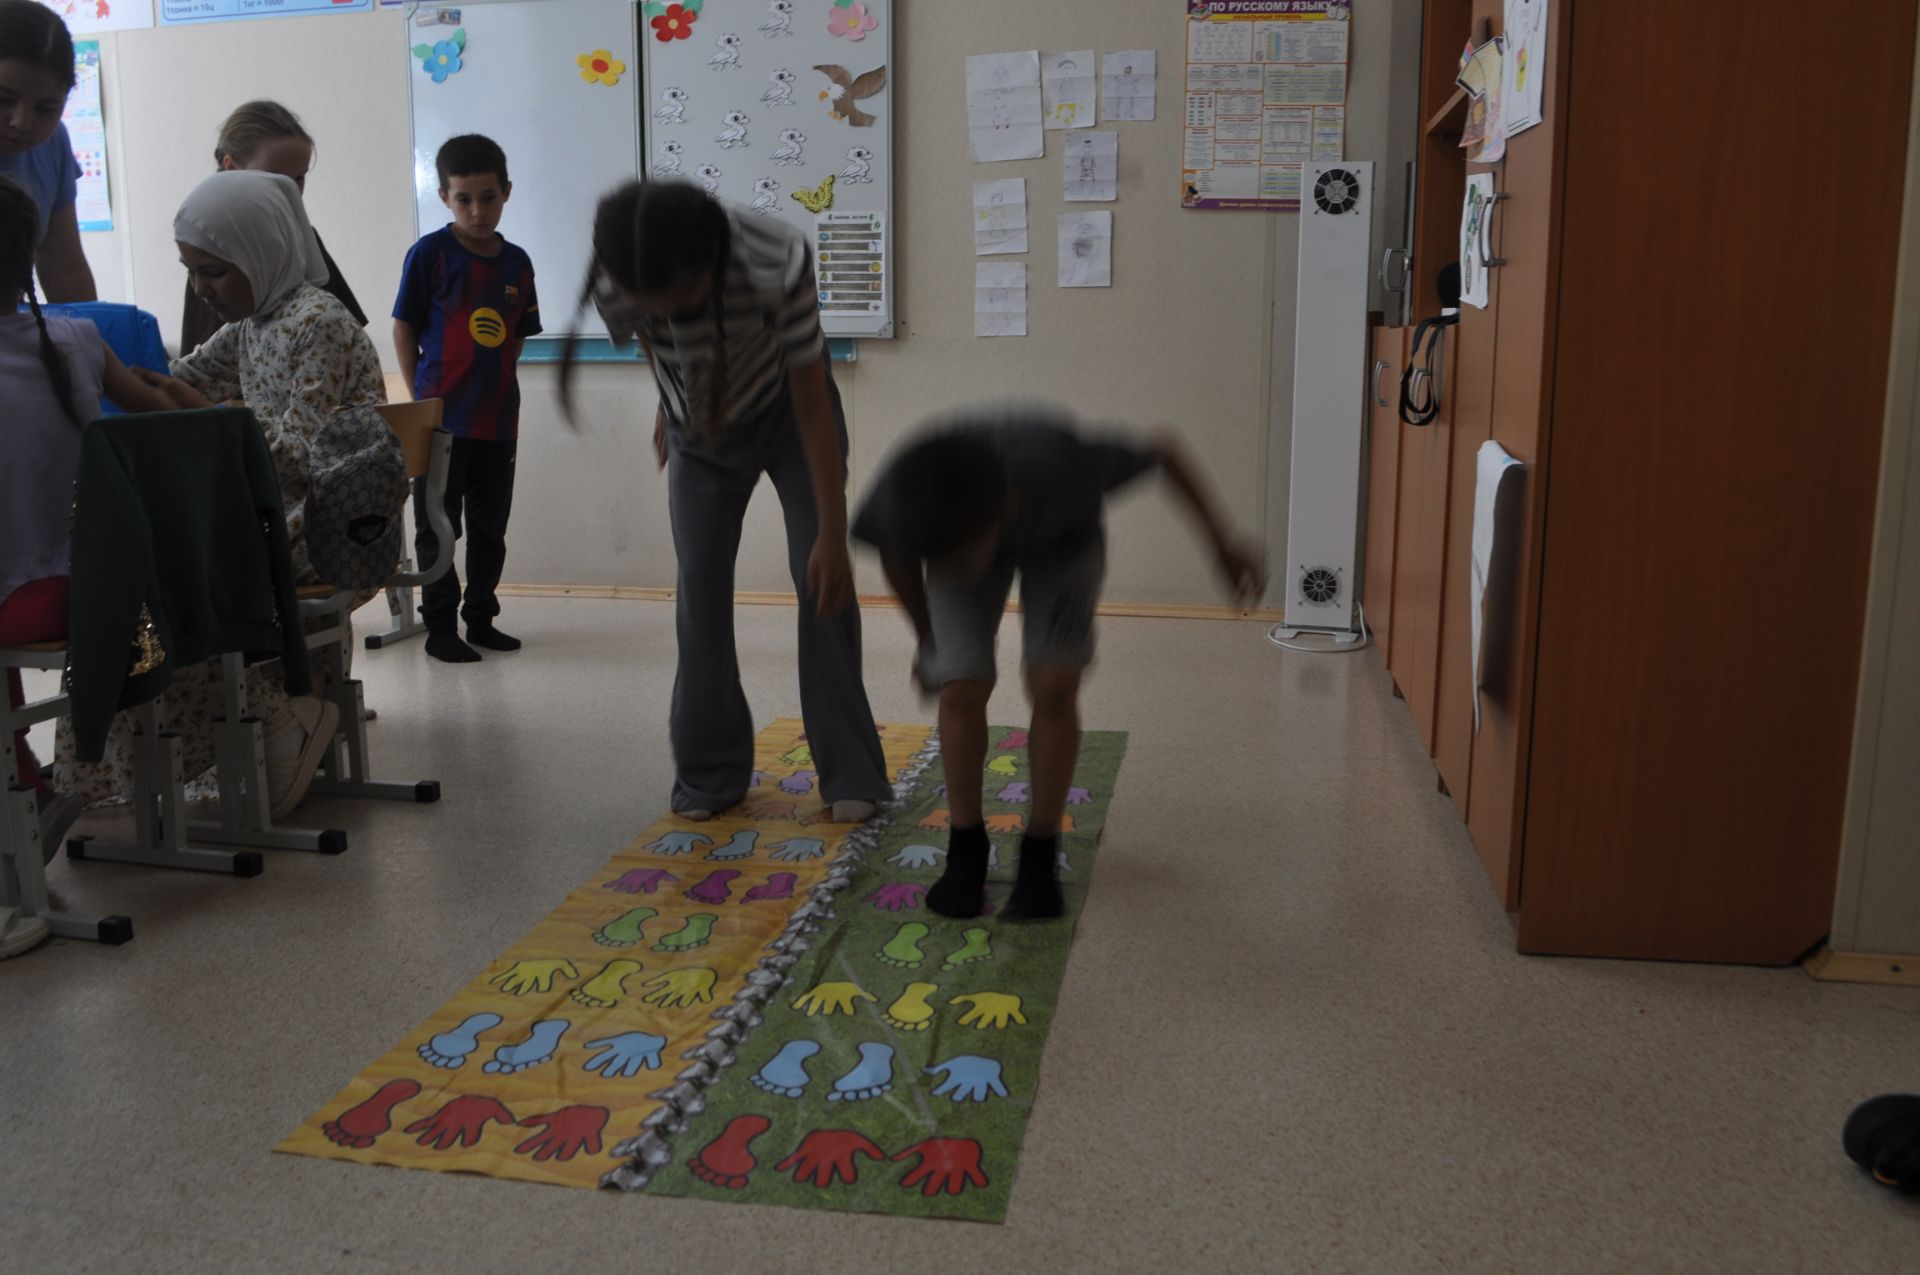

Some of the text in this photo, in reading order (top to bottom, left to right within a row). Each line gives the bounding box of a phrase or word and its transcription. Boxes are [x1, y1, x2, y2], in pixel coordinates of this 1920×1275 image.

[1210, 1, 1331, 11] ПО РУССКОМУ ЯЗЫКУ
